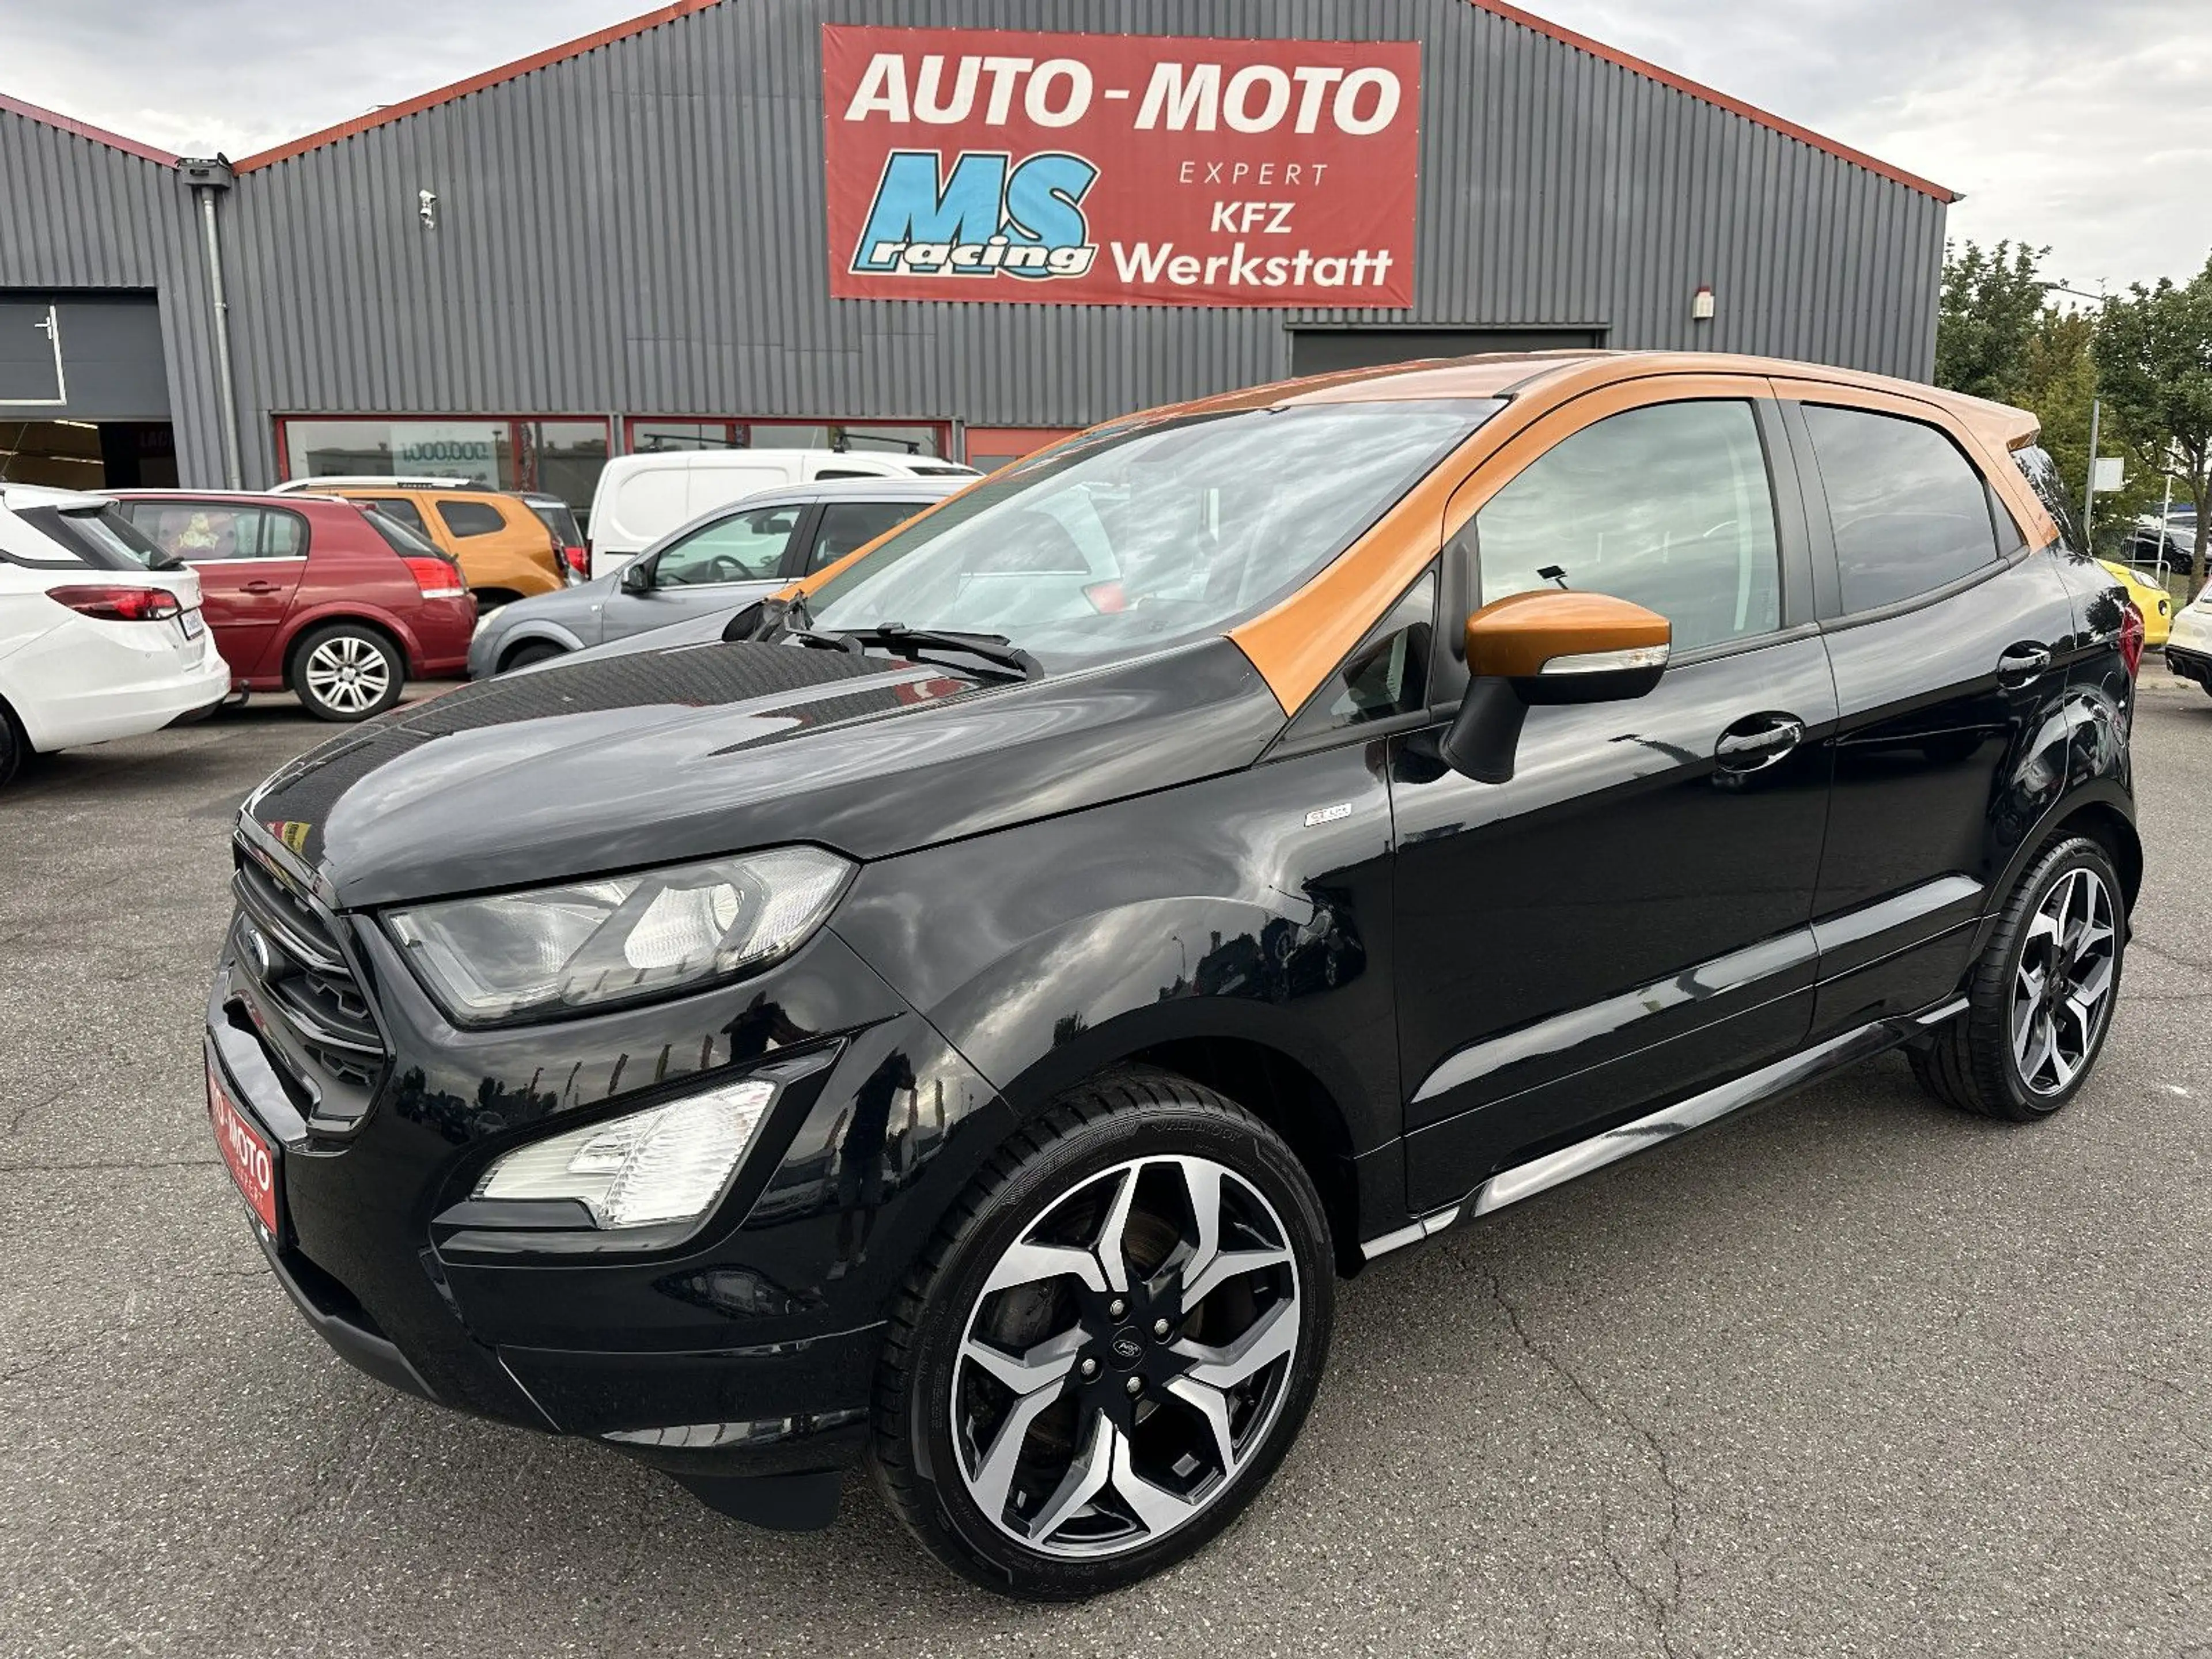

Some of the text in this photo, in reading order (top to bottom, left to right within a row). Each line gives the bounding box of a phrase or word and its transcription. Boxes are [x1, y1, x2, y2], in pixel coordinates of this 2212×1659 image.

[844, 54, 1093, 128] AUTO
[1134, 62, 1401, 135] MOTO
[1179, 161, 1328, 185] EXPERT
[851, 151, 1098, 279] MS
[1211, 201, 1296, 233] KFZ
[868, 234, 1097, 275] racing
[1110, 241, 1393, 287] Werkstatt
[228, 1109, 270, 1192] MOTO
